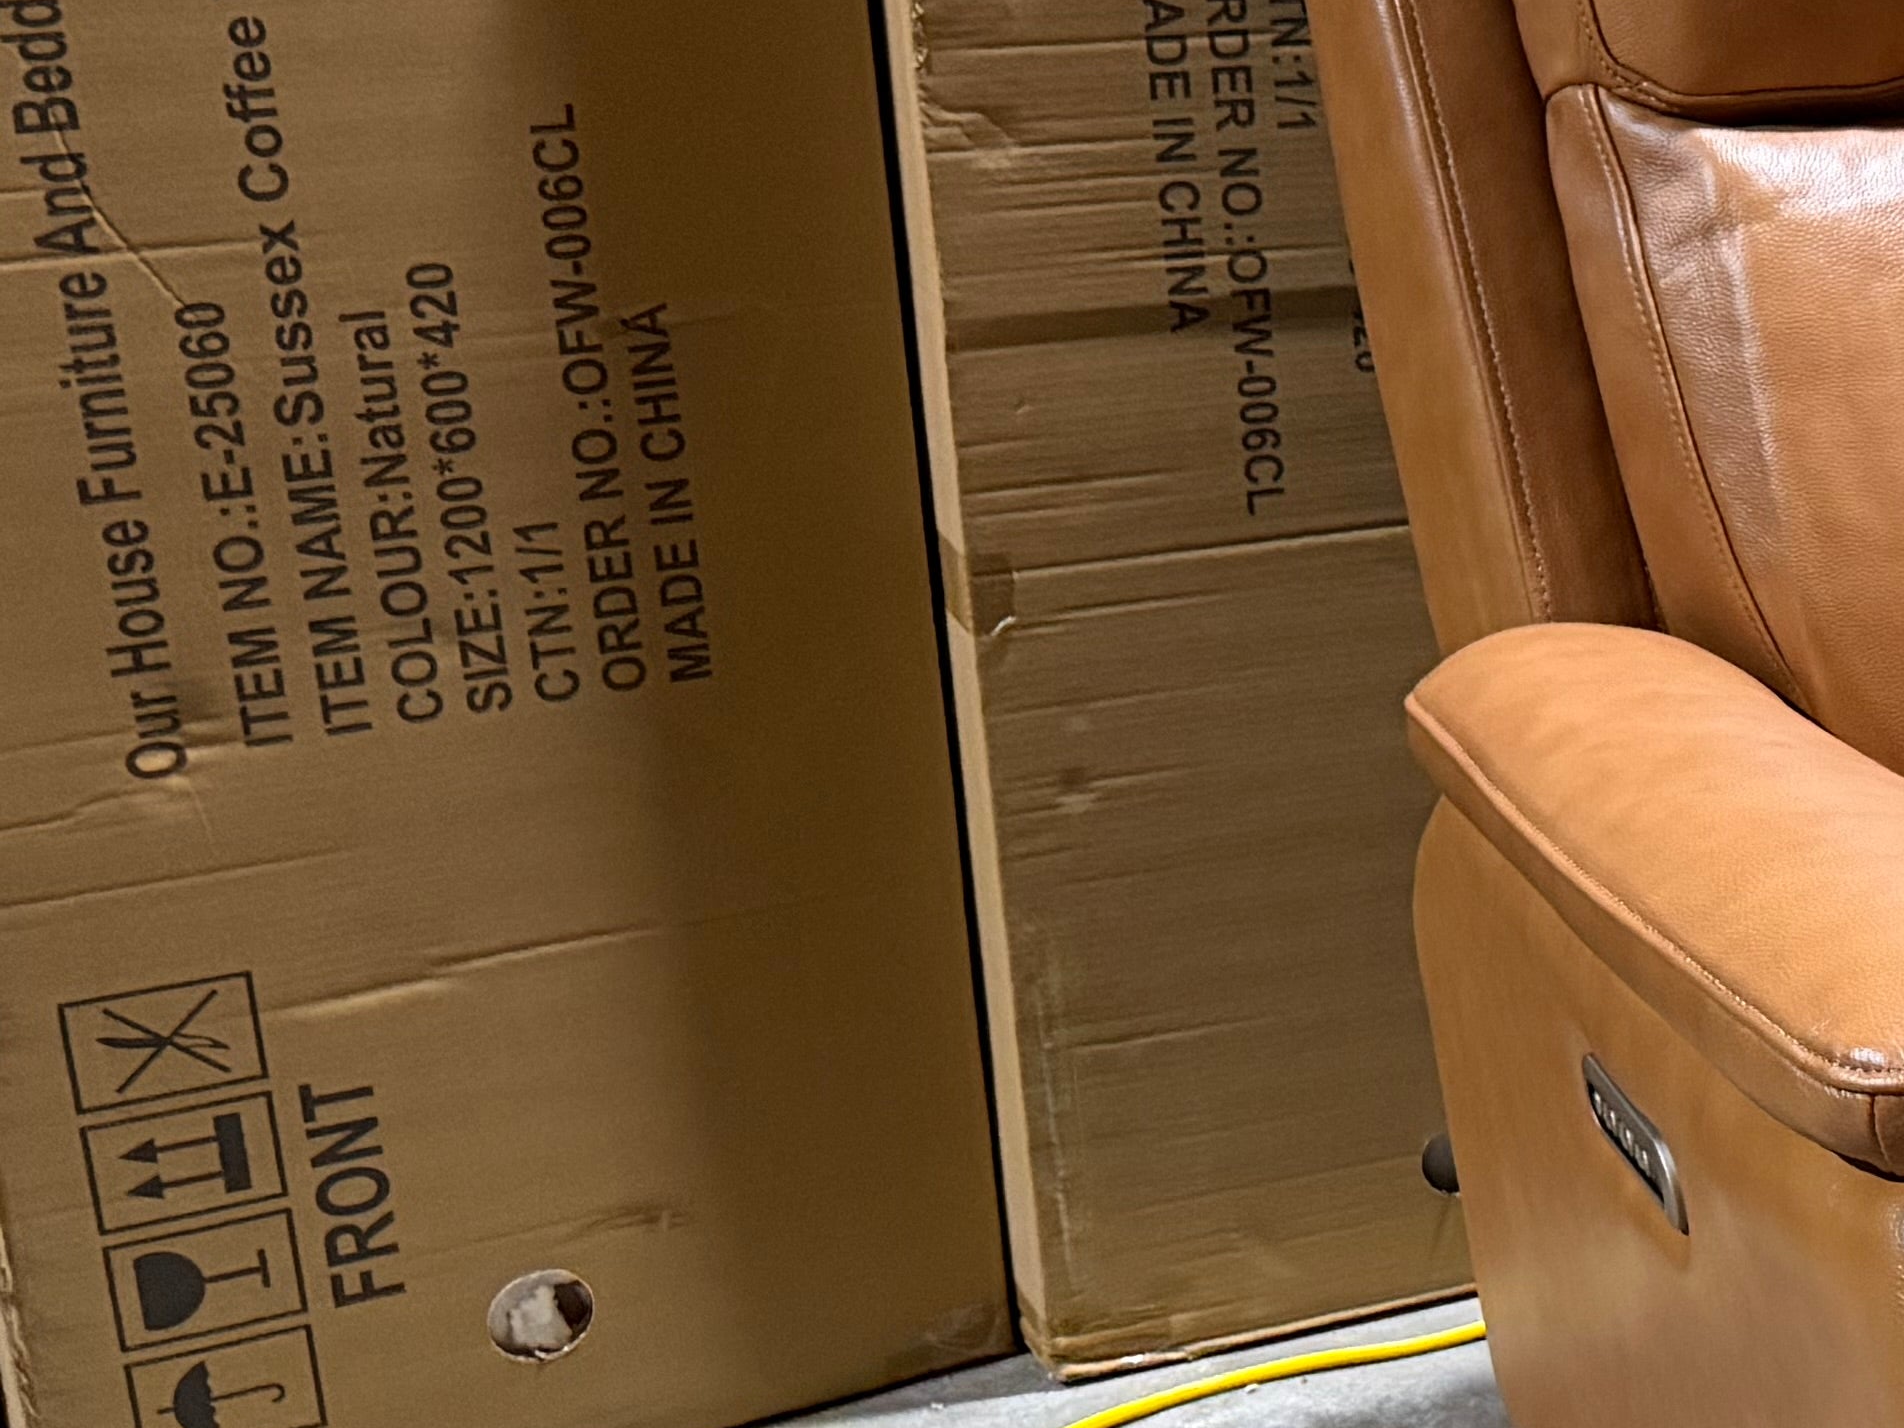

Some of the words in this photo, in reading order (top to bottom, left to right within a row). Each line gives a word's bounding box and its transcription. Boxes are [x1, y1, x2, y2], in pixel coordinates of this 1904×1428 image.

[226, 15, 290, 203] Coffee
[1153, 117, 1197, 164] IN
[20, 149, 99, 256] And
[1158, 180, 1210, 333] CHINA
[59, 271, 143, 506] Furniture
[259, 220, 352, 602] NAME:Sussex
[624, 303, 686, 463] CHINA
[338, 310, 444, 724] COLOUR:Natural
[644, 476, 696, 525] IN
[105, 518, 171, 678] House
[309, 613, 373, 738] ITEM
[512, 522, 581, 703] CTN:1/1
[584, 517, 648, 693] ORDER
[654, 540, 713, 684] MADE
[125, 690, 188, 780] Our
[227, 626, 293, 748] ITEM
[300, 1083, 406, 1309] FRONT
